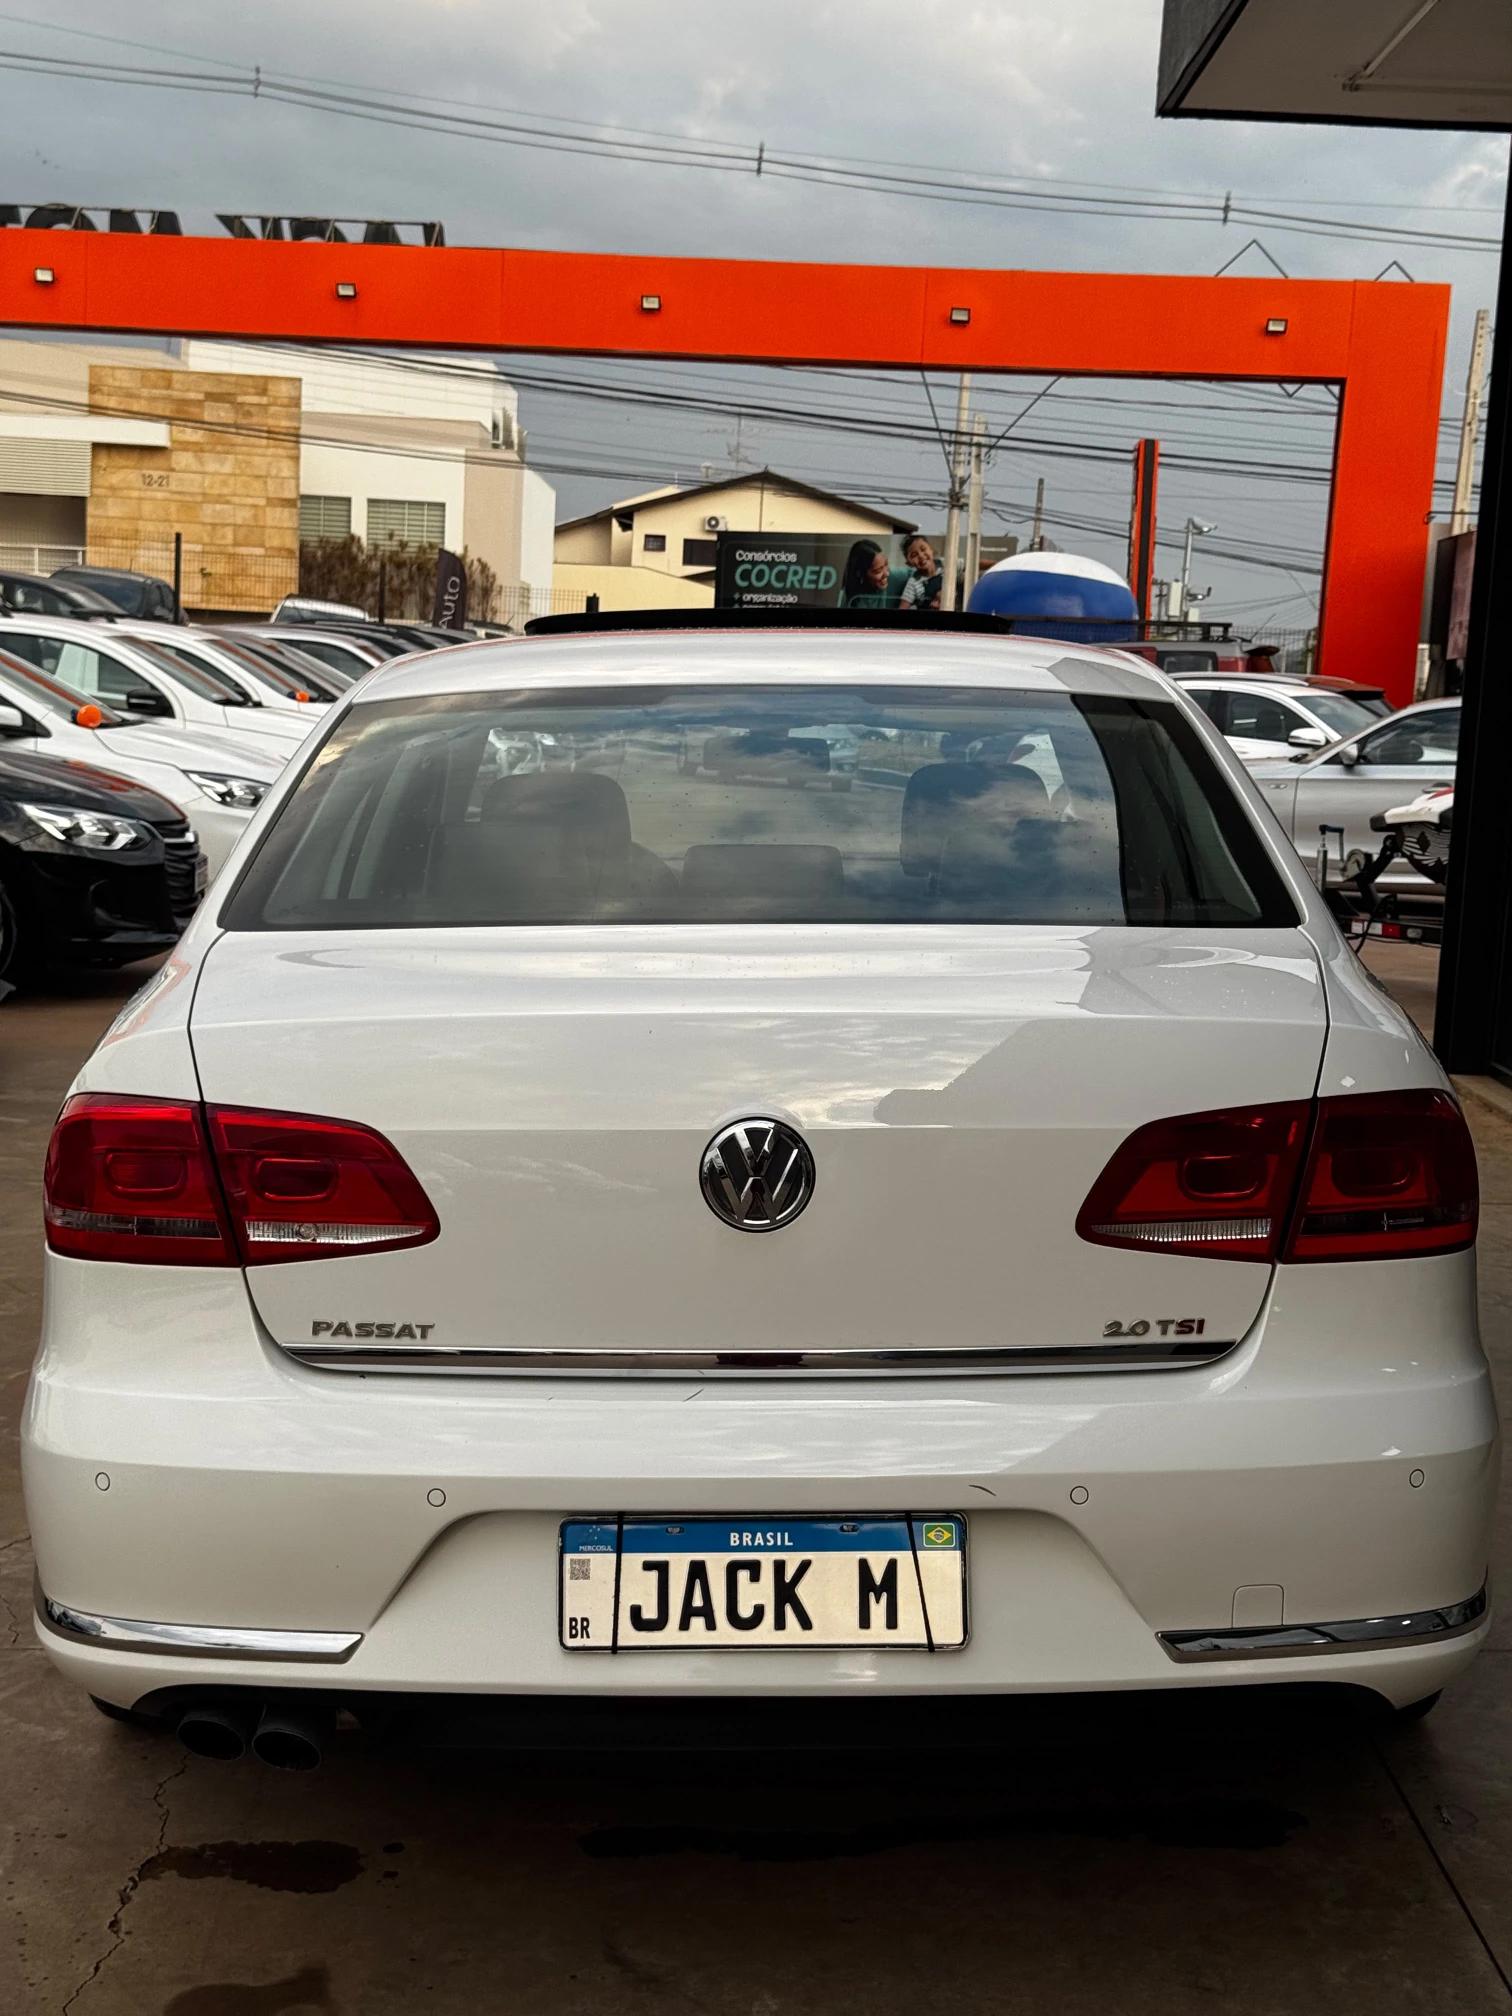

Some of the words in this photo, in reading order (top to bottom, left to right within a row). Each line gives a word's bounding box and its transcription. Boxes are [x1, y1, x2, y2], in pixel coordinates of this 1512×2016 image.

[735, 550, 797, 562] Consórcios
[735, 564, 837, 590] COCRED
[439, 576, 460, 629] Auto
[742, 593, 798, 604] organização
[312, 1320, 435, 1339] PASSAT
[1103, 1320, 1150, 1337] 2.0
[1156, 1318, 1205, 1336] TSI
[729, 1532, 794, 1546] BRASIL
[630, 1559, 813, 1631] JACK
[858, 1558, 898, 1629] M
[569, 1617, 591, 1638] BR
